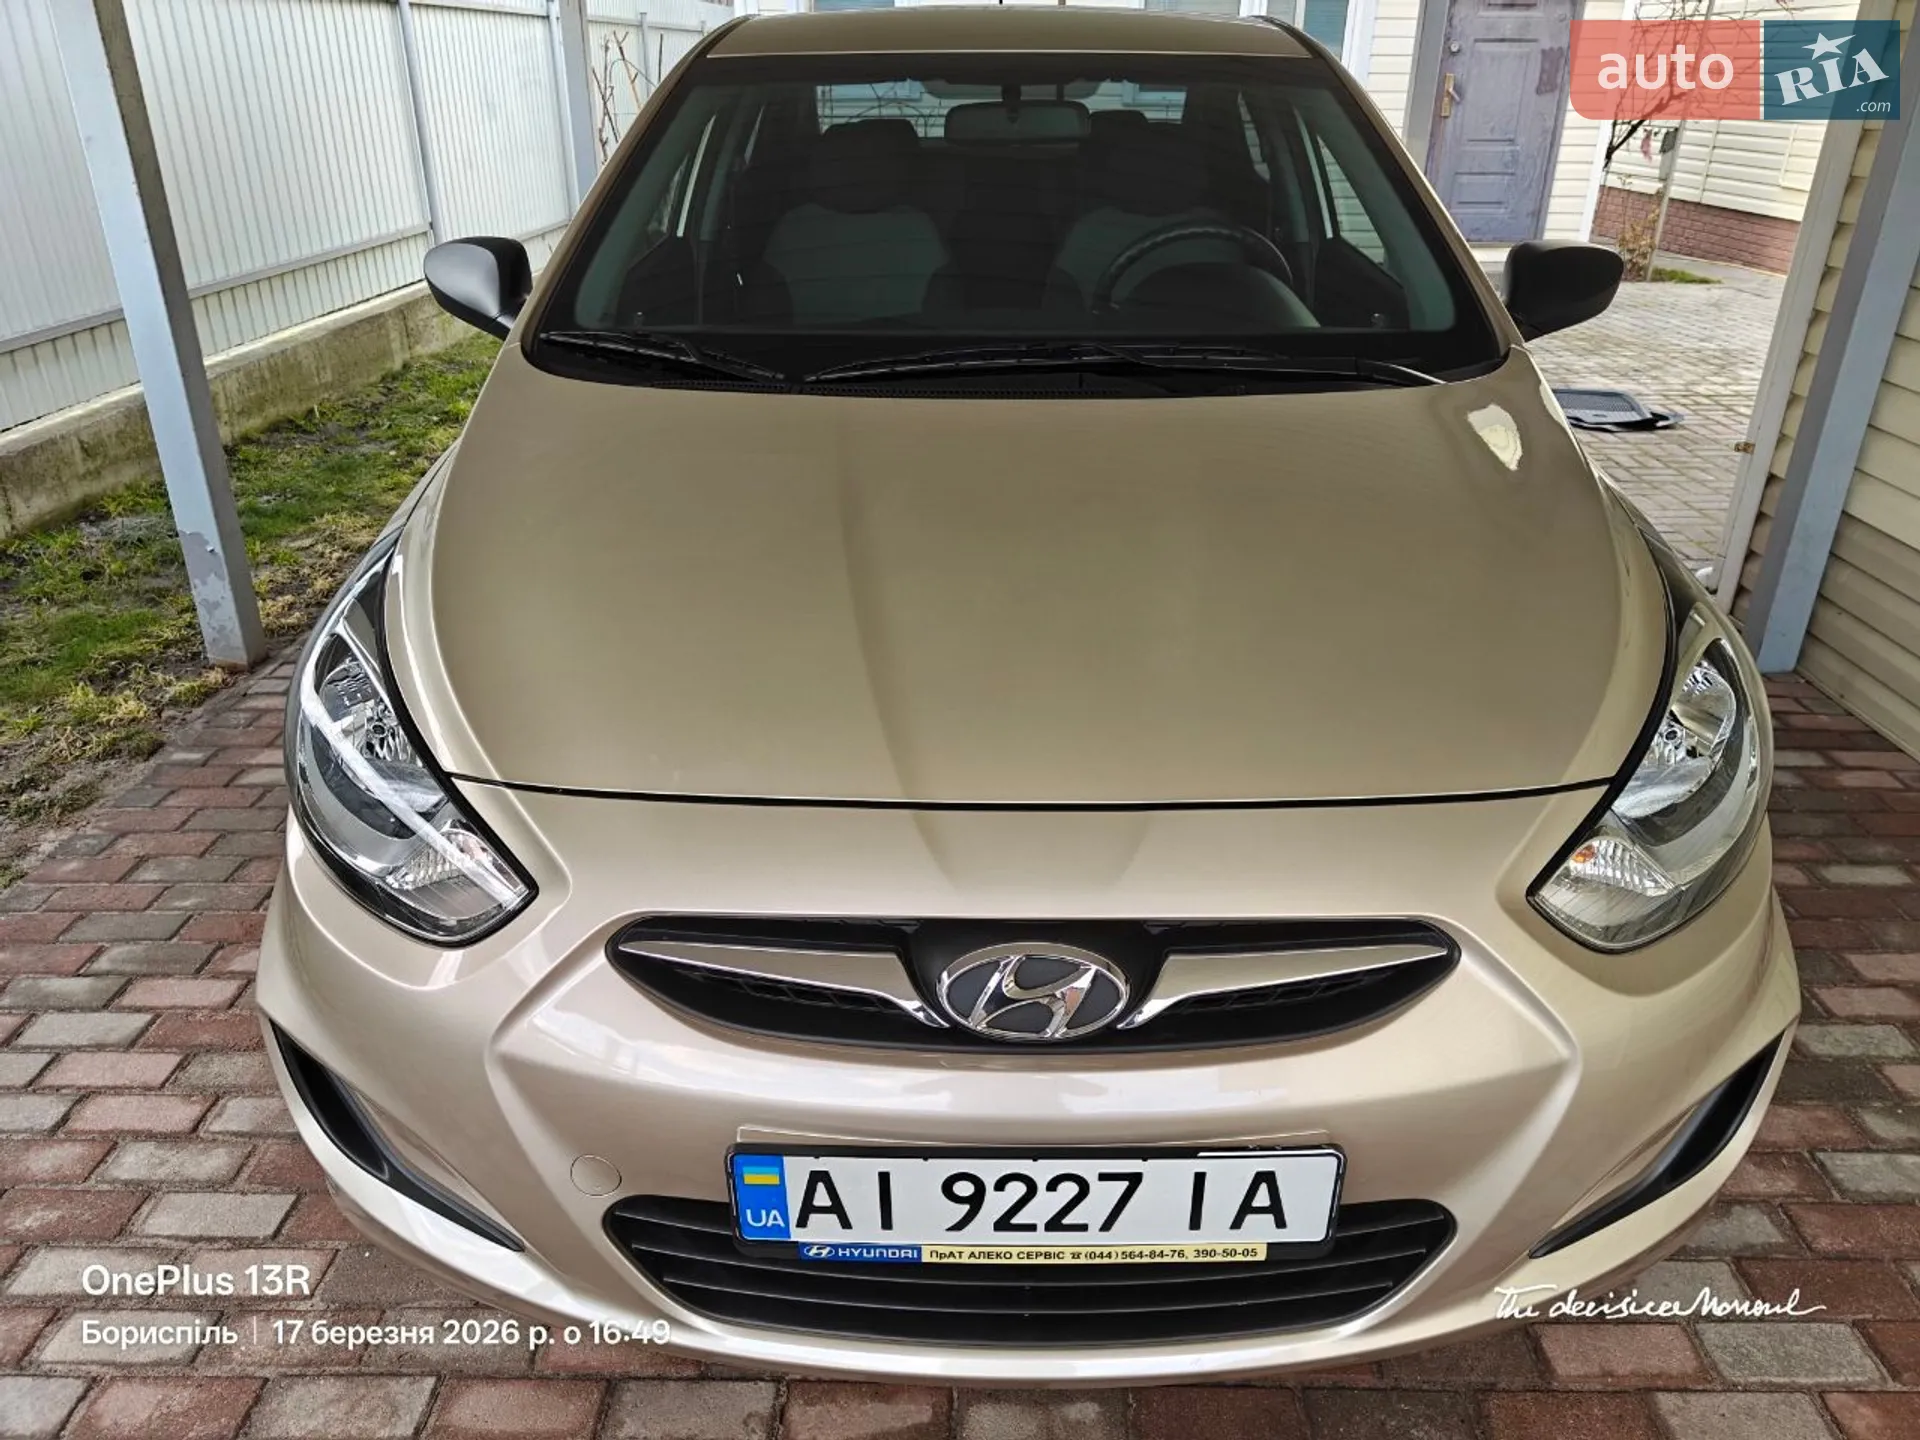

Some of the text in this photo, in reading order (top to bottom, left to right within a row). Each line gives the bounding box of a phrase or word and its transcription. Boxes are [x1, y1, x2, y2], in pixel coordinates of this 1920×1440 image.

[795, 1169, 1288, 1233] AI 9227 IA
[746, 1208, 786, 1228] UA
[838, 1247, 918, 1259] HYUNDAI
[929, 1249, 965, 1261] ПрАТ
[967, 1250, 1013, 1260] АЛЕКО
[1016, 1250, 1066, 1260] СЕРВІС
[1193, 1248, 1258, 1259] 390-50-05
